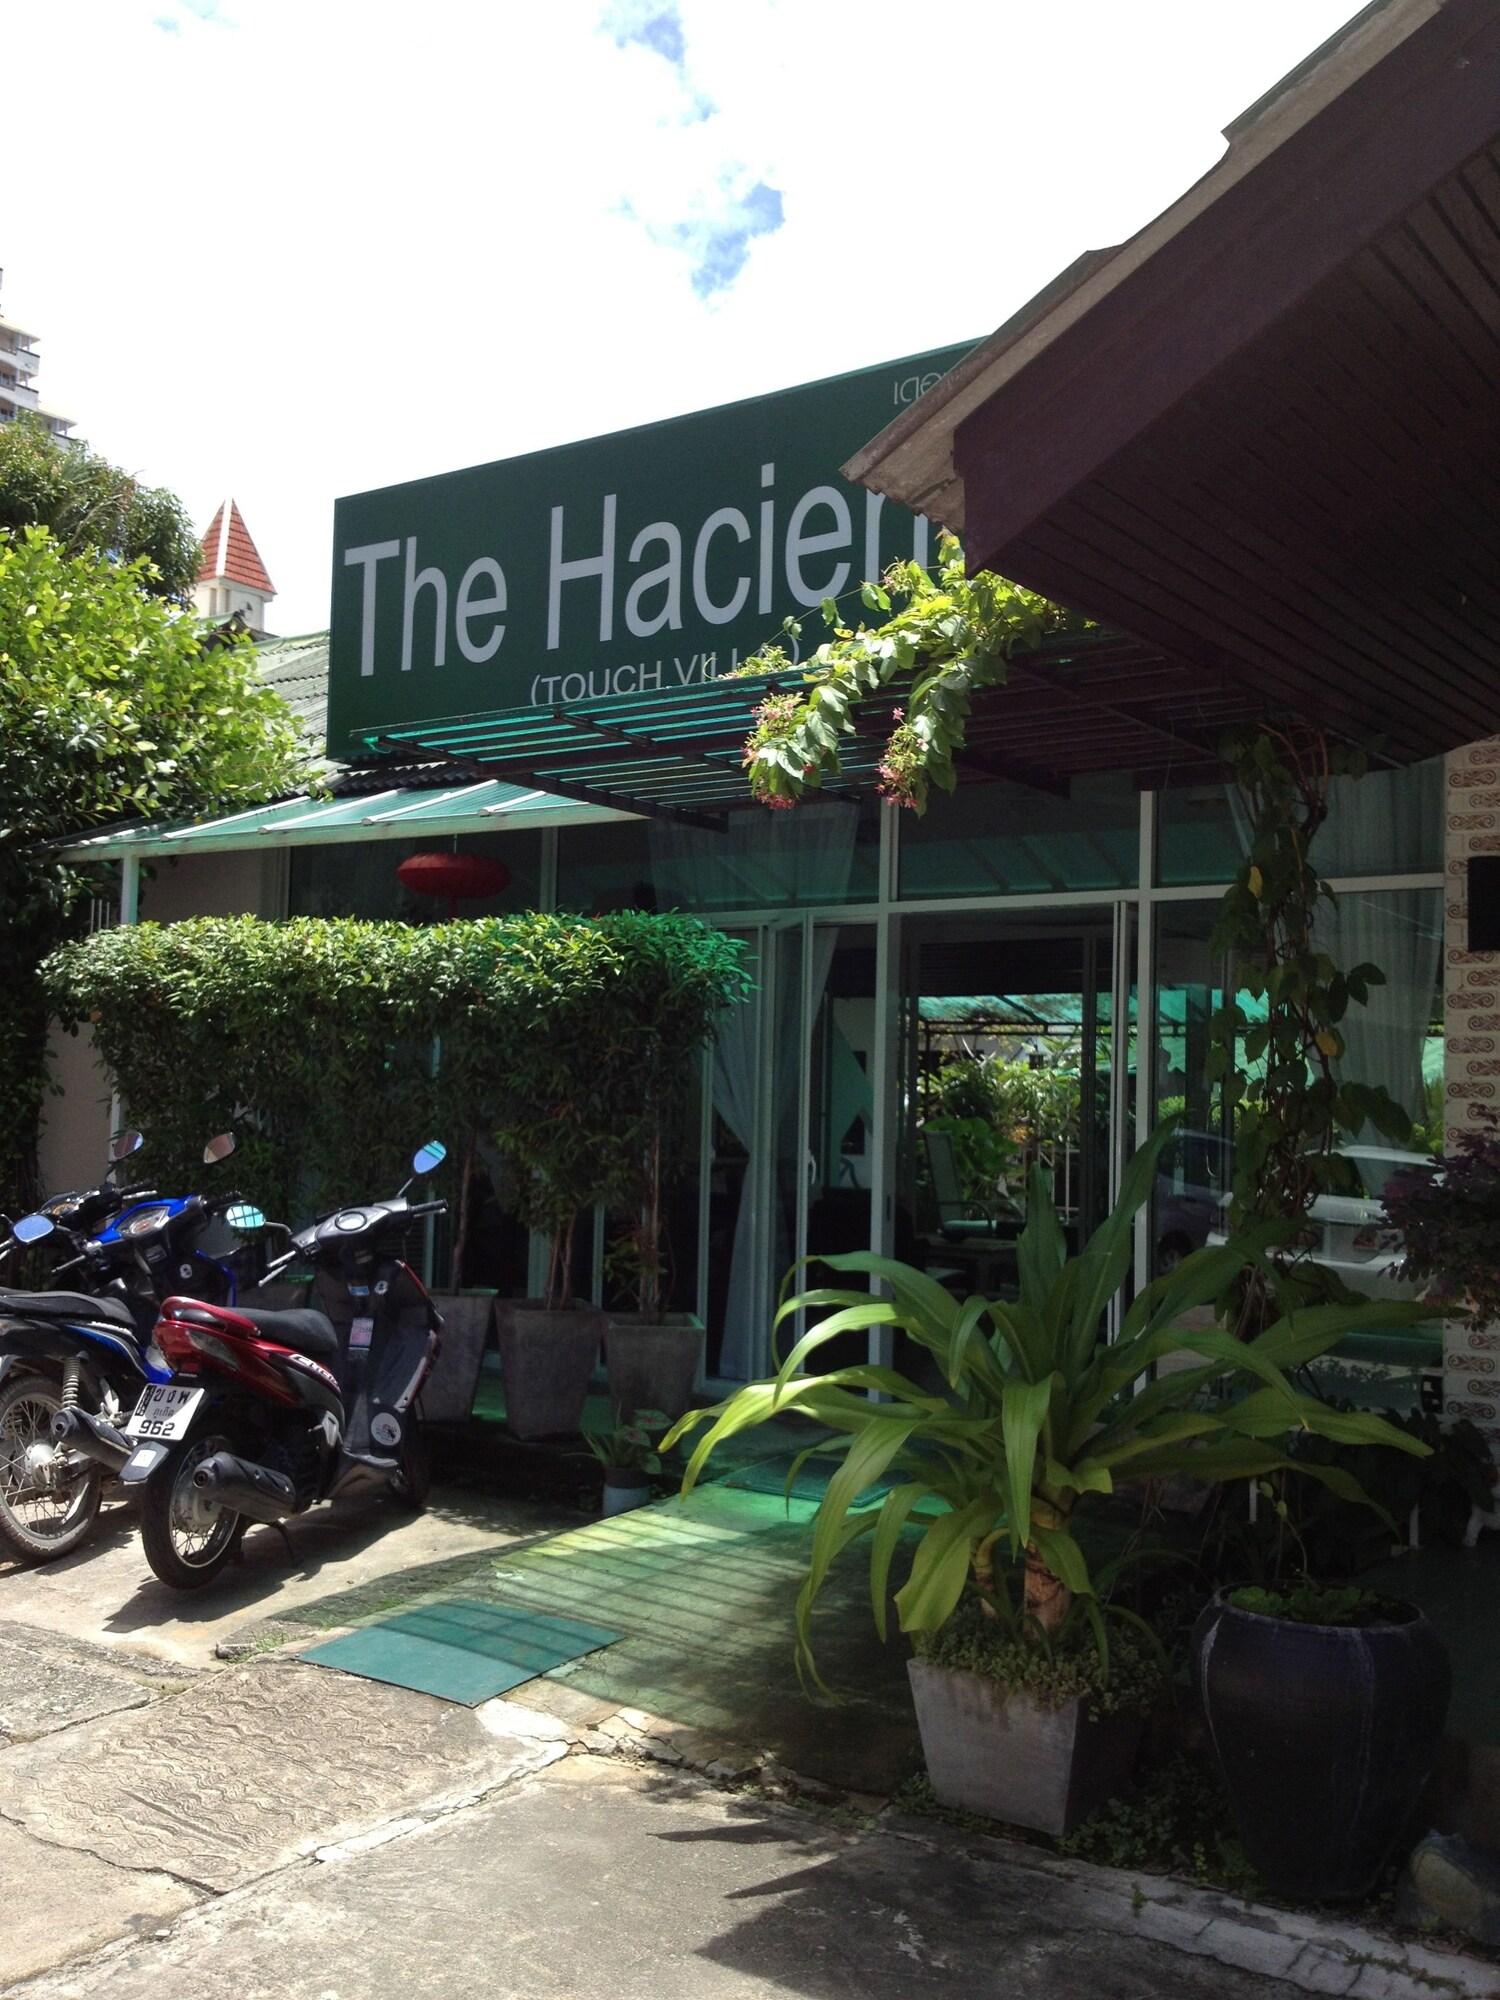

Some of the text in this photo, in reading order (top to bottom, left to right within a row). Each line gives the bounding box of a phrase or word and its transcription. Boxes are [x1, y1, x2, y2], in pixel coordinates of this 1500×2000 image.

[343, 535, 508, 677] The
[530, 660, 662, 706] (TOUCH
[138, 1419, 176, 1437] 962
